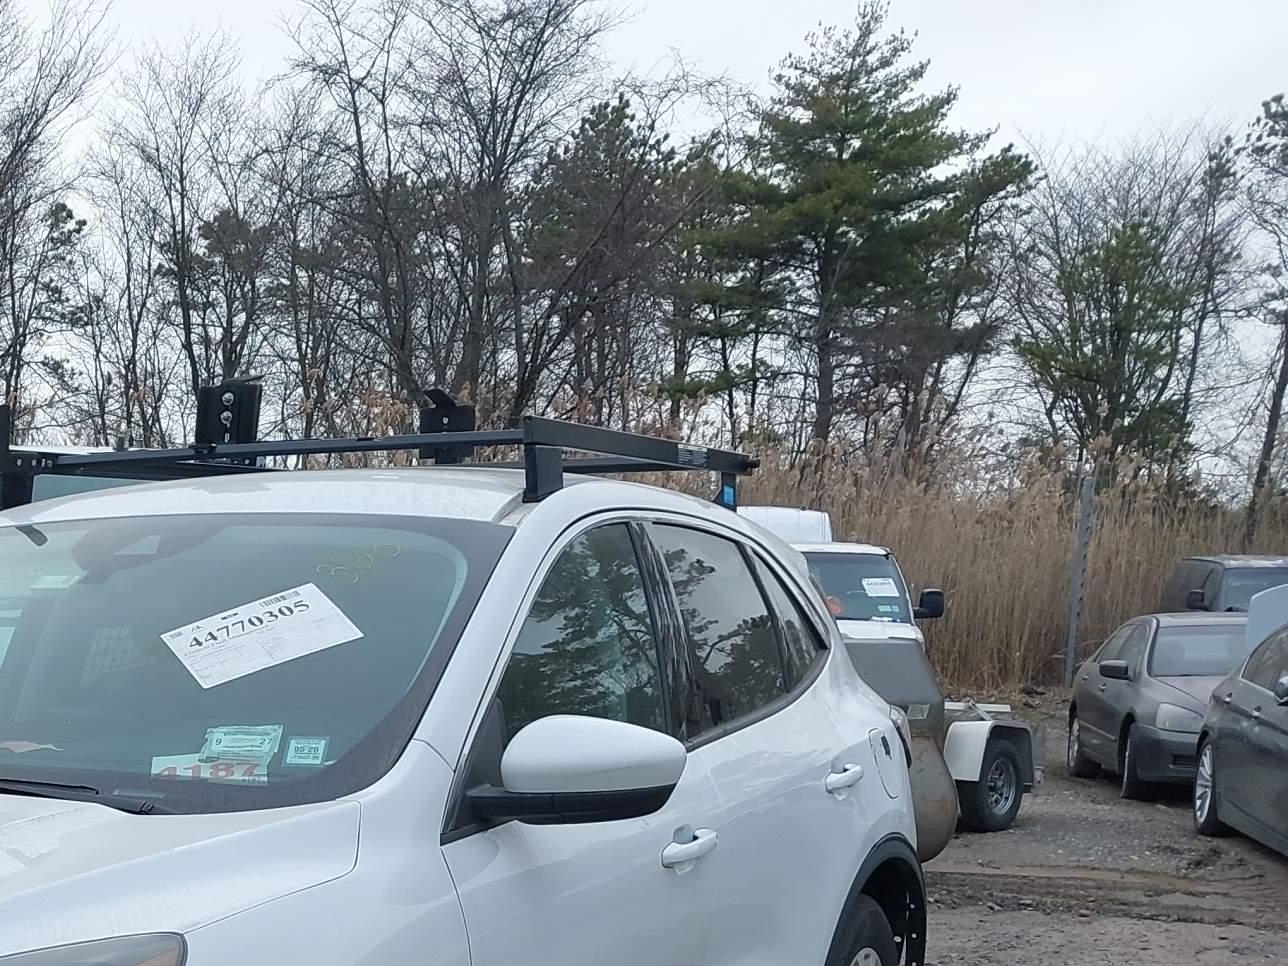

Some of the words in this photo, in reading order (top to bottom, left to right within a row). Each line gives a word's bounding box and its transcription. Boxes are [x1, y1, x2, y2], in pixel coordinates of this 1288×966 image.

[188, 599, 311, 648] 44770305
[215, 738, 223, 746] 9
[258, 737, 273, 746] 27
[153, 762, 260, 781] 4187
